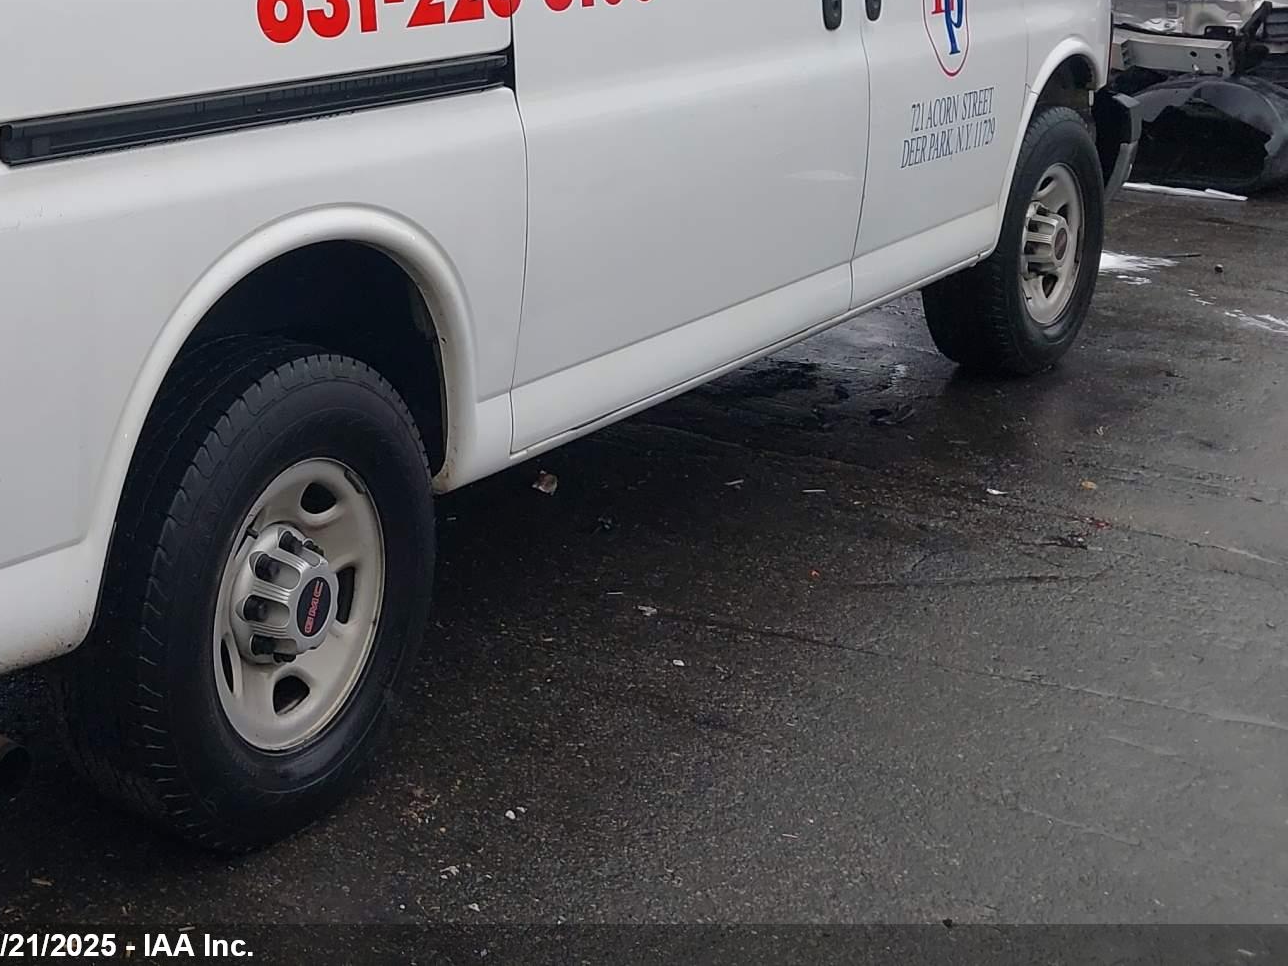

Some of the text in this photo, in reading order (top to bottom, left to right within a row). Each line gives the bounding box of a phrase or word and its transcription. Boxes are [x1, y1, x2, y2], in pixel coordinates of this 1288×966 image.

[911, 86, 995, 133] 721 ACORN STREET
[900, 135, 928, 169] DEER
[972, 116, 996, 149] 11729
[304, 579, 324, 634] GMC
